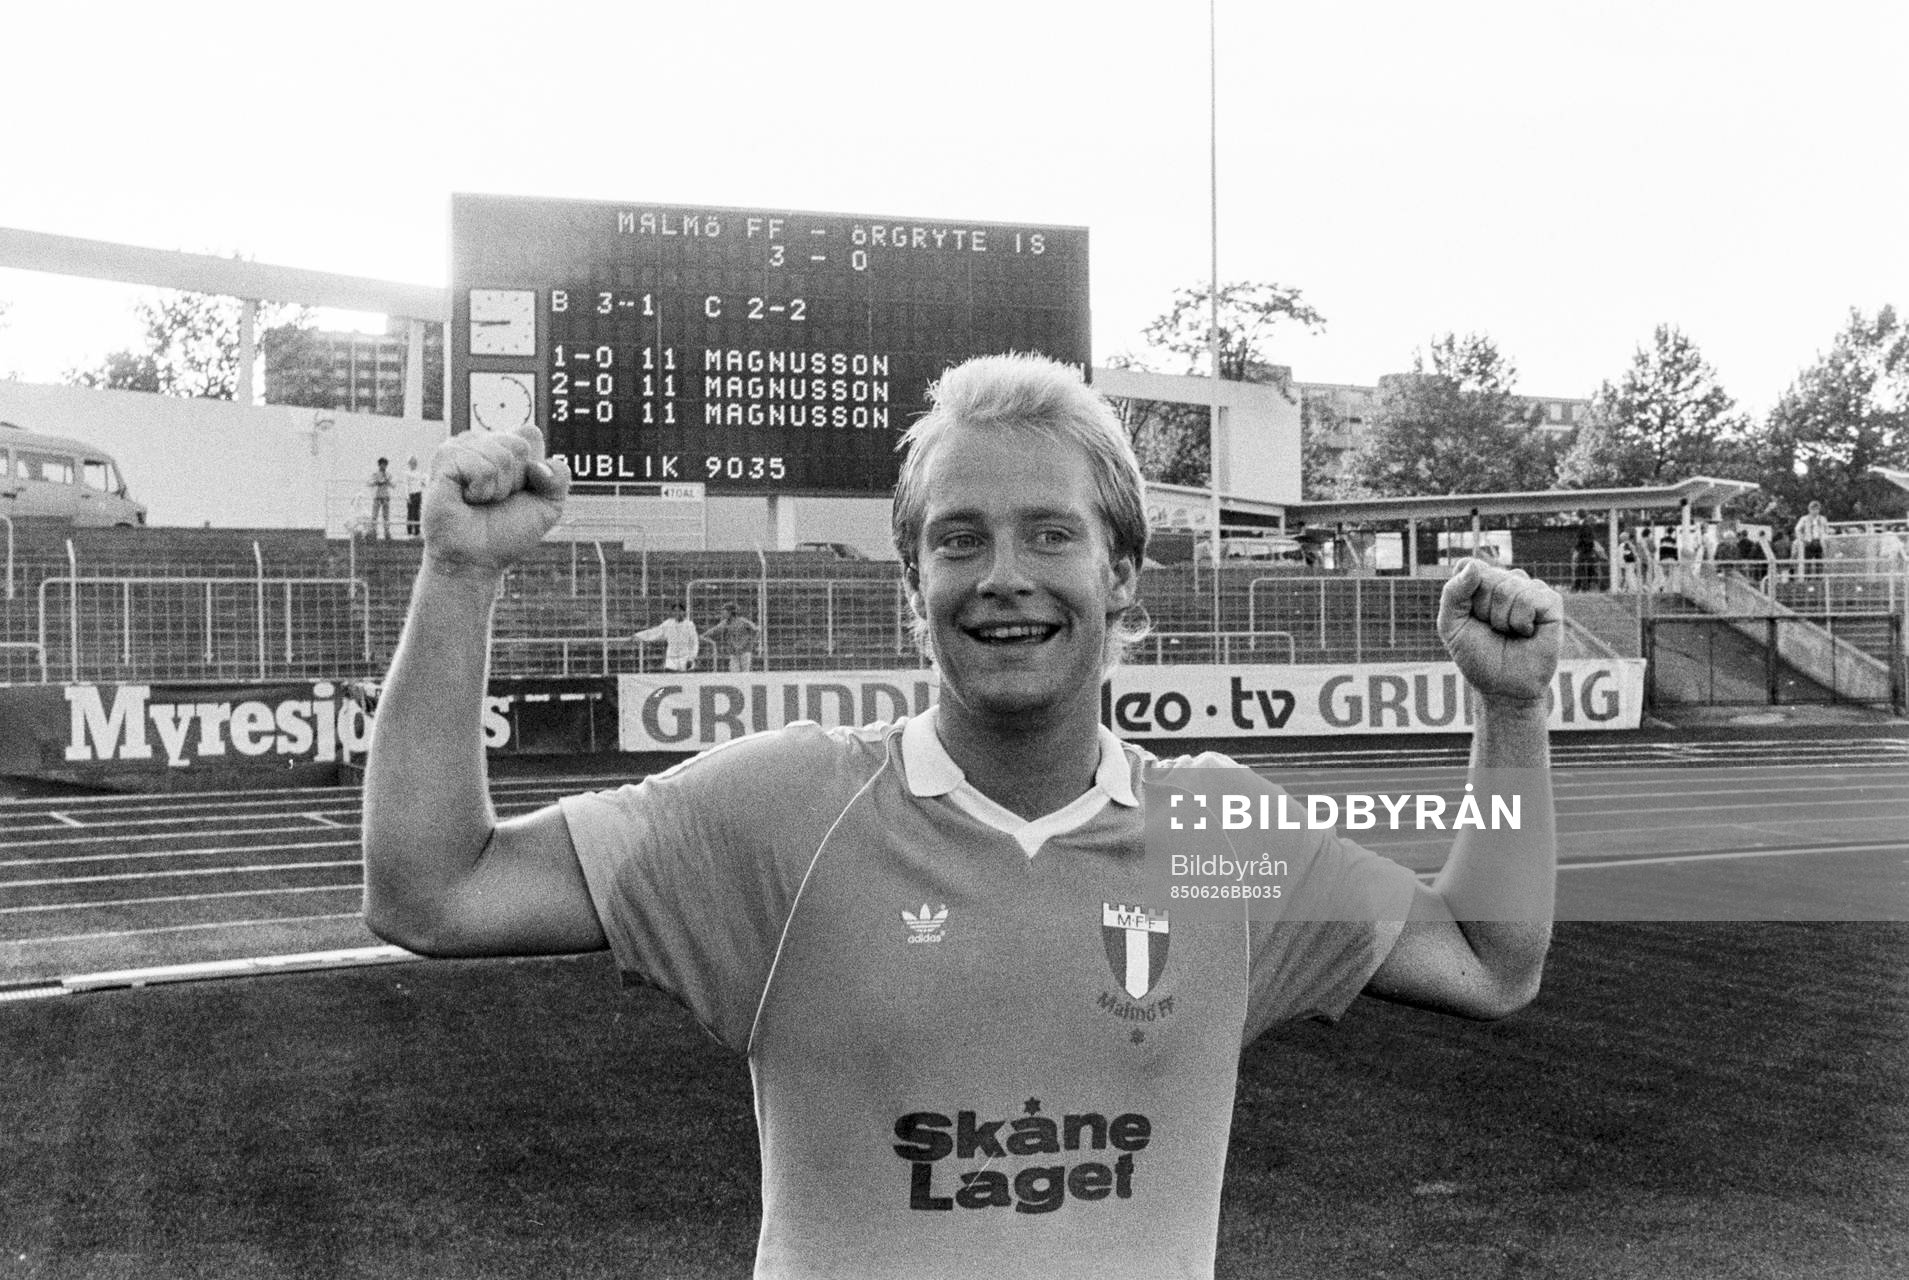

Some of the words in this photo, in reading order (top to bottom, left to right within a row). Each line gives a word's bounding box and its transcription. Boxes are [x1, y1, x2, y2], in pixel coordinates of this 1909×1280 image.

[747, 217, 784, 239] FF
[1016, 233, 1045, 254] IS
[769, 245, 784, 266] 3
[852, 250, 867, 270] 0
[552, 290, 568, 311] B
[705, 296, 721, 317] C
[748, 297, 806, 320] 2-2
[555, 345, 613, 368] 1-0
[643, 347, 675, 370] 11
[705, 349, 888, 376] MAGNUSSON
[552, 372, 613, 395] 2-0
[643, 375, 675, 397] 11
[705, 376, 888, 402] MAGNUSSON
[552, 399, 613, 422] 3-0
[643, 401, 675, 424] 11
[705, 402, 888, 429] MAGNUSSON
[706, 457, 785, 479] 9035
[1231, 676, 1295, 730] tv
[1318, 669, 1620, 728] GRUIG
[65, 682, 514, 767] Myresjs
[907, 934, 942, 943] adidas
[893, 1097, 1152, 1162] Skåne
[910, 1153, 1135, 1215] Laget
